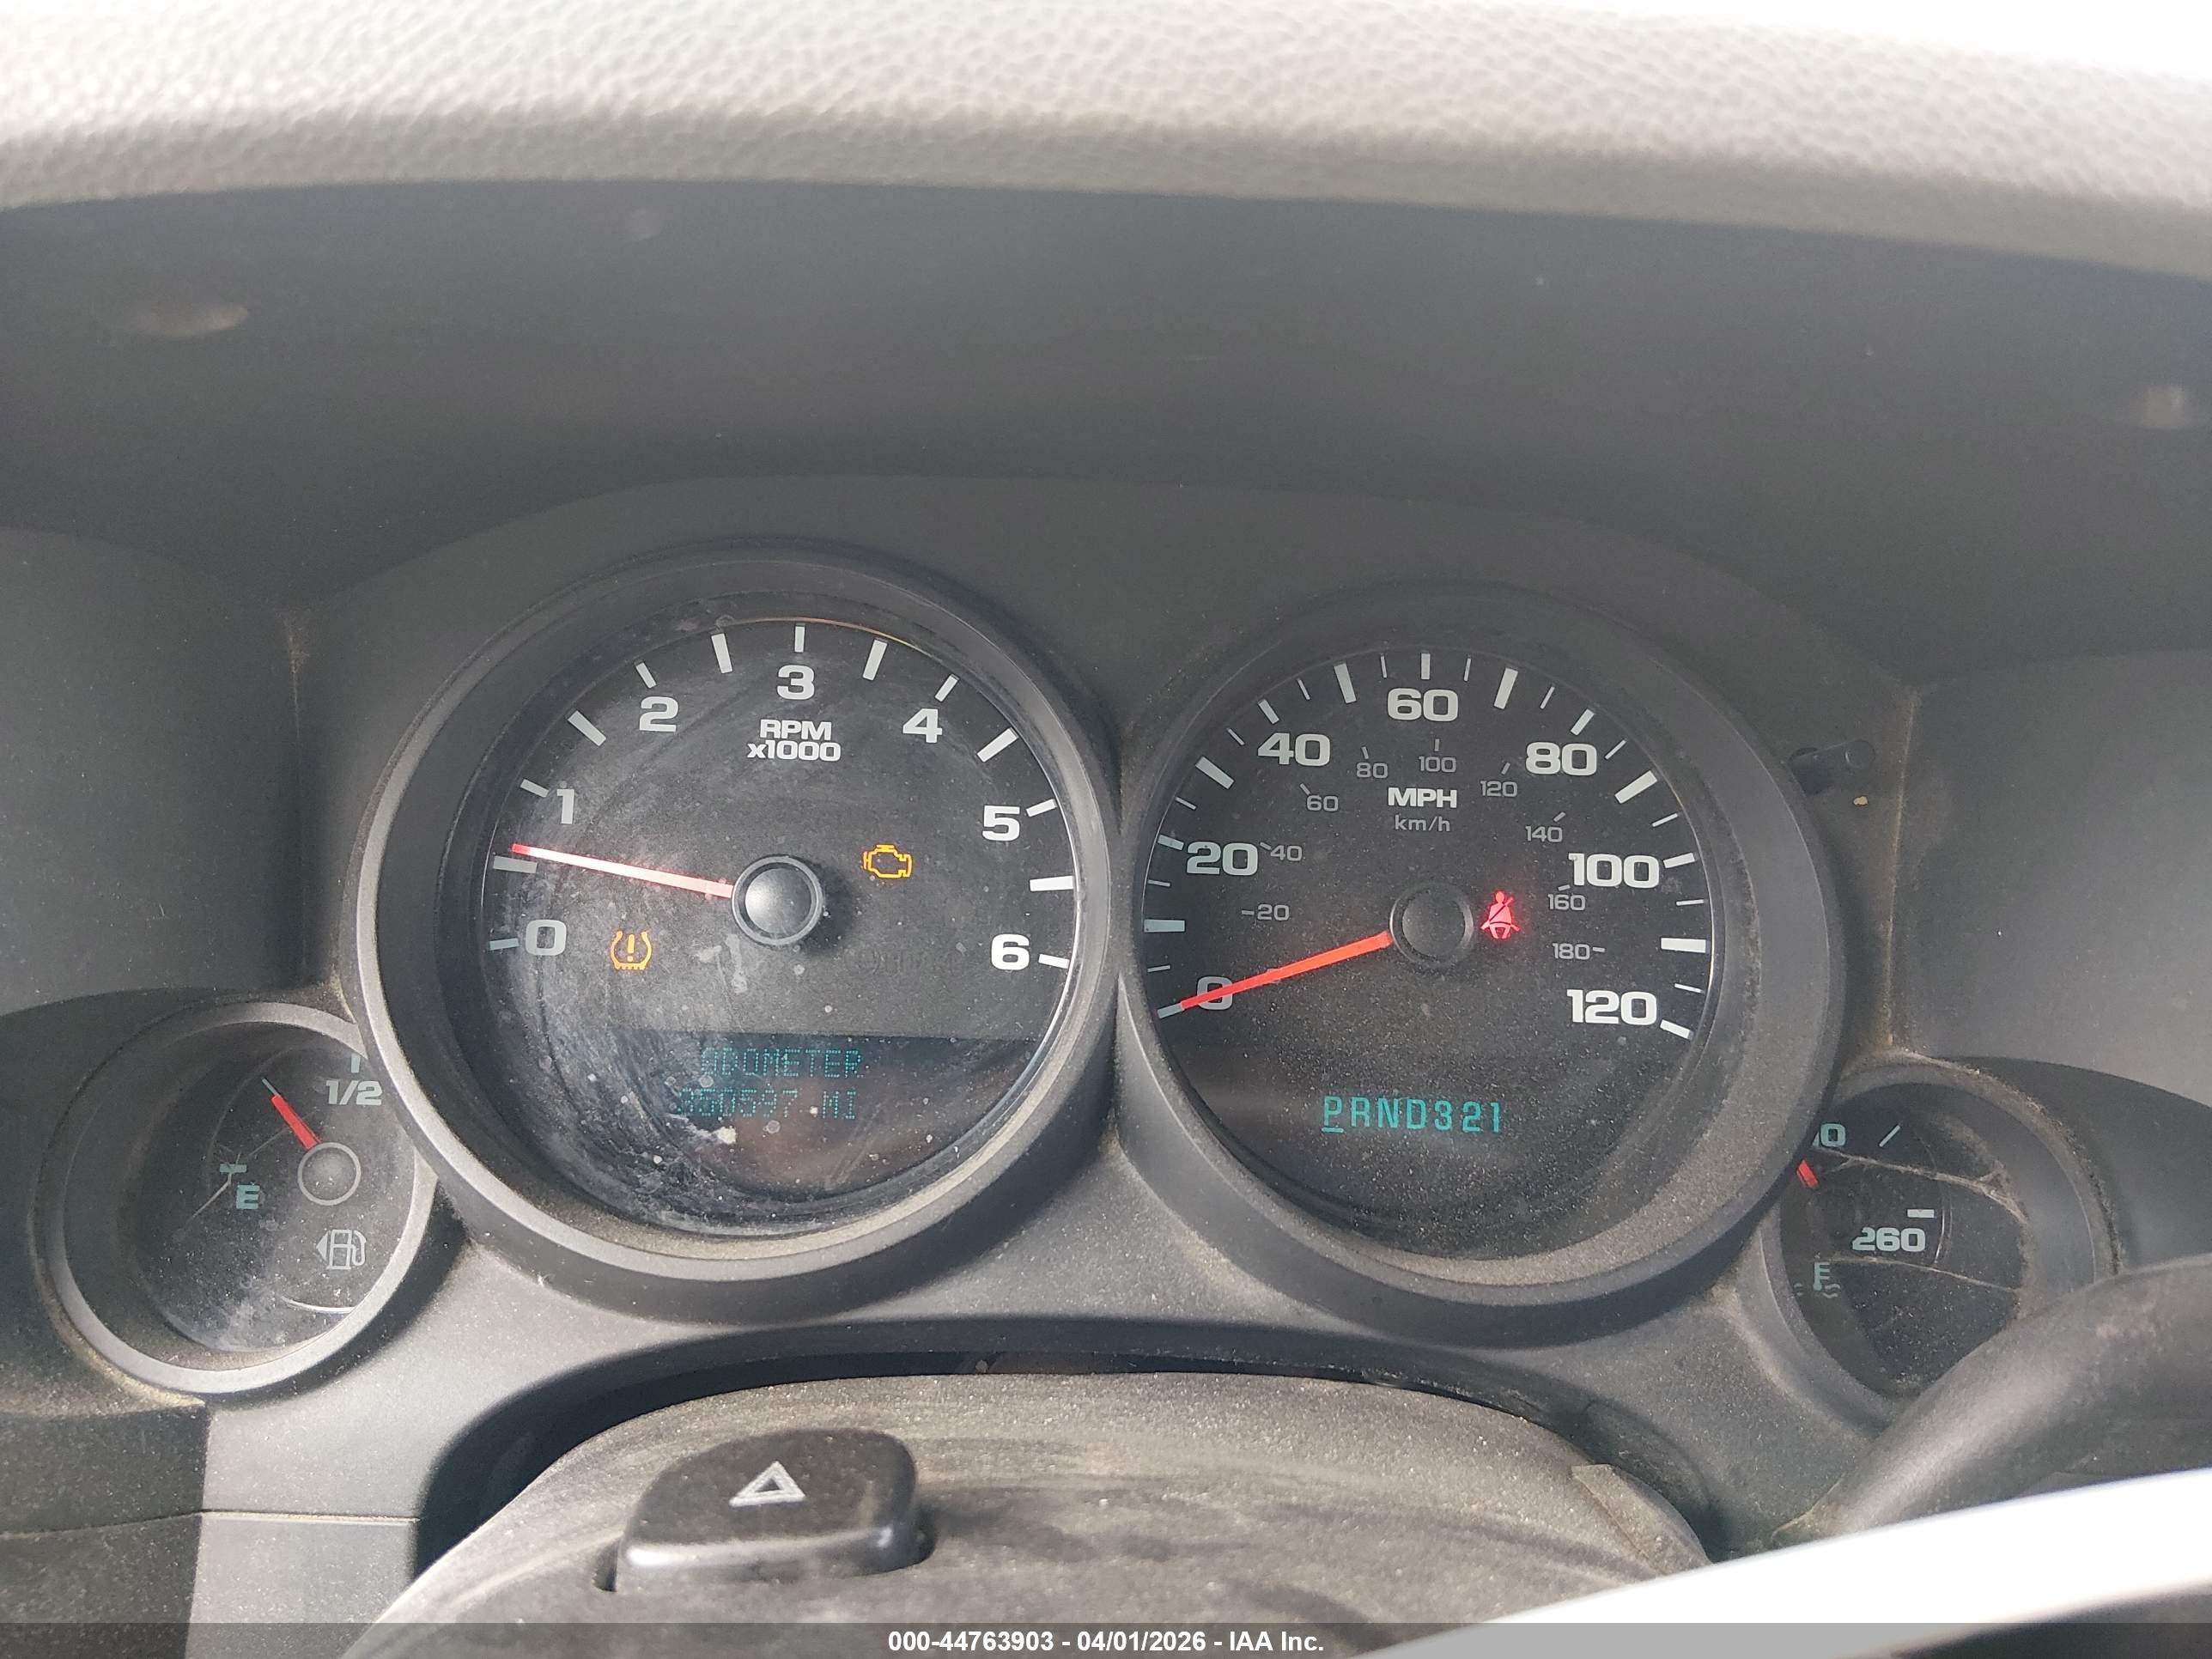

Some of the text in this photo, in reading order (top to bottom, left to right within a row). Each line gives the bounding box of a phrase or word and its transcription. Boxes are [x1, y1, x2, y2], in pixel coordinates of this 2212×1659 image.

[777, 665, 815, 700] 3
[640, 696, 679, 732] 2
[1388, 689, 1458, 722] 60
[760, 720, 832, 740] RPM
[903, 708, 943, 744] 4
[747, 740, 842, 762] x1000
[1258, 733, 1331, 766] 40
[1526, 742, 1597, 775] 80
[1356, 762, 1389, 779] 80
[1419, 757, 1456, 773] 100
[1388, 787, 1457, 808] MPH
[1480, 781, 1518, 798] 120
[557, 788, 575, 825] 1
[1307, 795, 1339, 811] 60
[982, 805, 1020, 842] 5
[1395, 815, 1450, 832] km/h
[1525, 825, 1563, 842] 140
[1188, 842, 1258, 876] 20
[1271, 845, 1303, 861] 40
[1569, 854, 1660, 889] 100
[1257, 904, 1290, 921] 20
[1547, 894, 1586, 911] 160
[526, 920, 567, 957] 0
[1553, 943, 1590, 960] 180
[992, 934, 1030, 970] 6
[1197, 976, 1233, 1010] 0
[1567, 989, 1657, 1026] 120
[326, 1080, 383, 1106] 1/2
[822, 1090, 856, 1120] MI
[236, 1184, 260, 1210] E
[1852, 1227, 1926, 1253] 260
